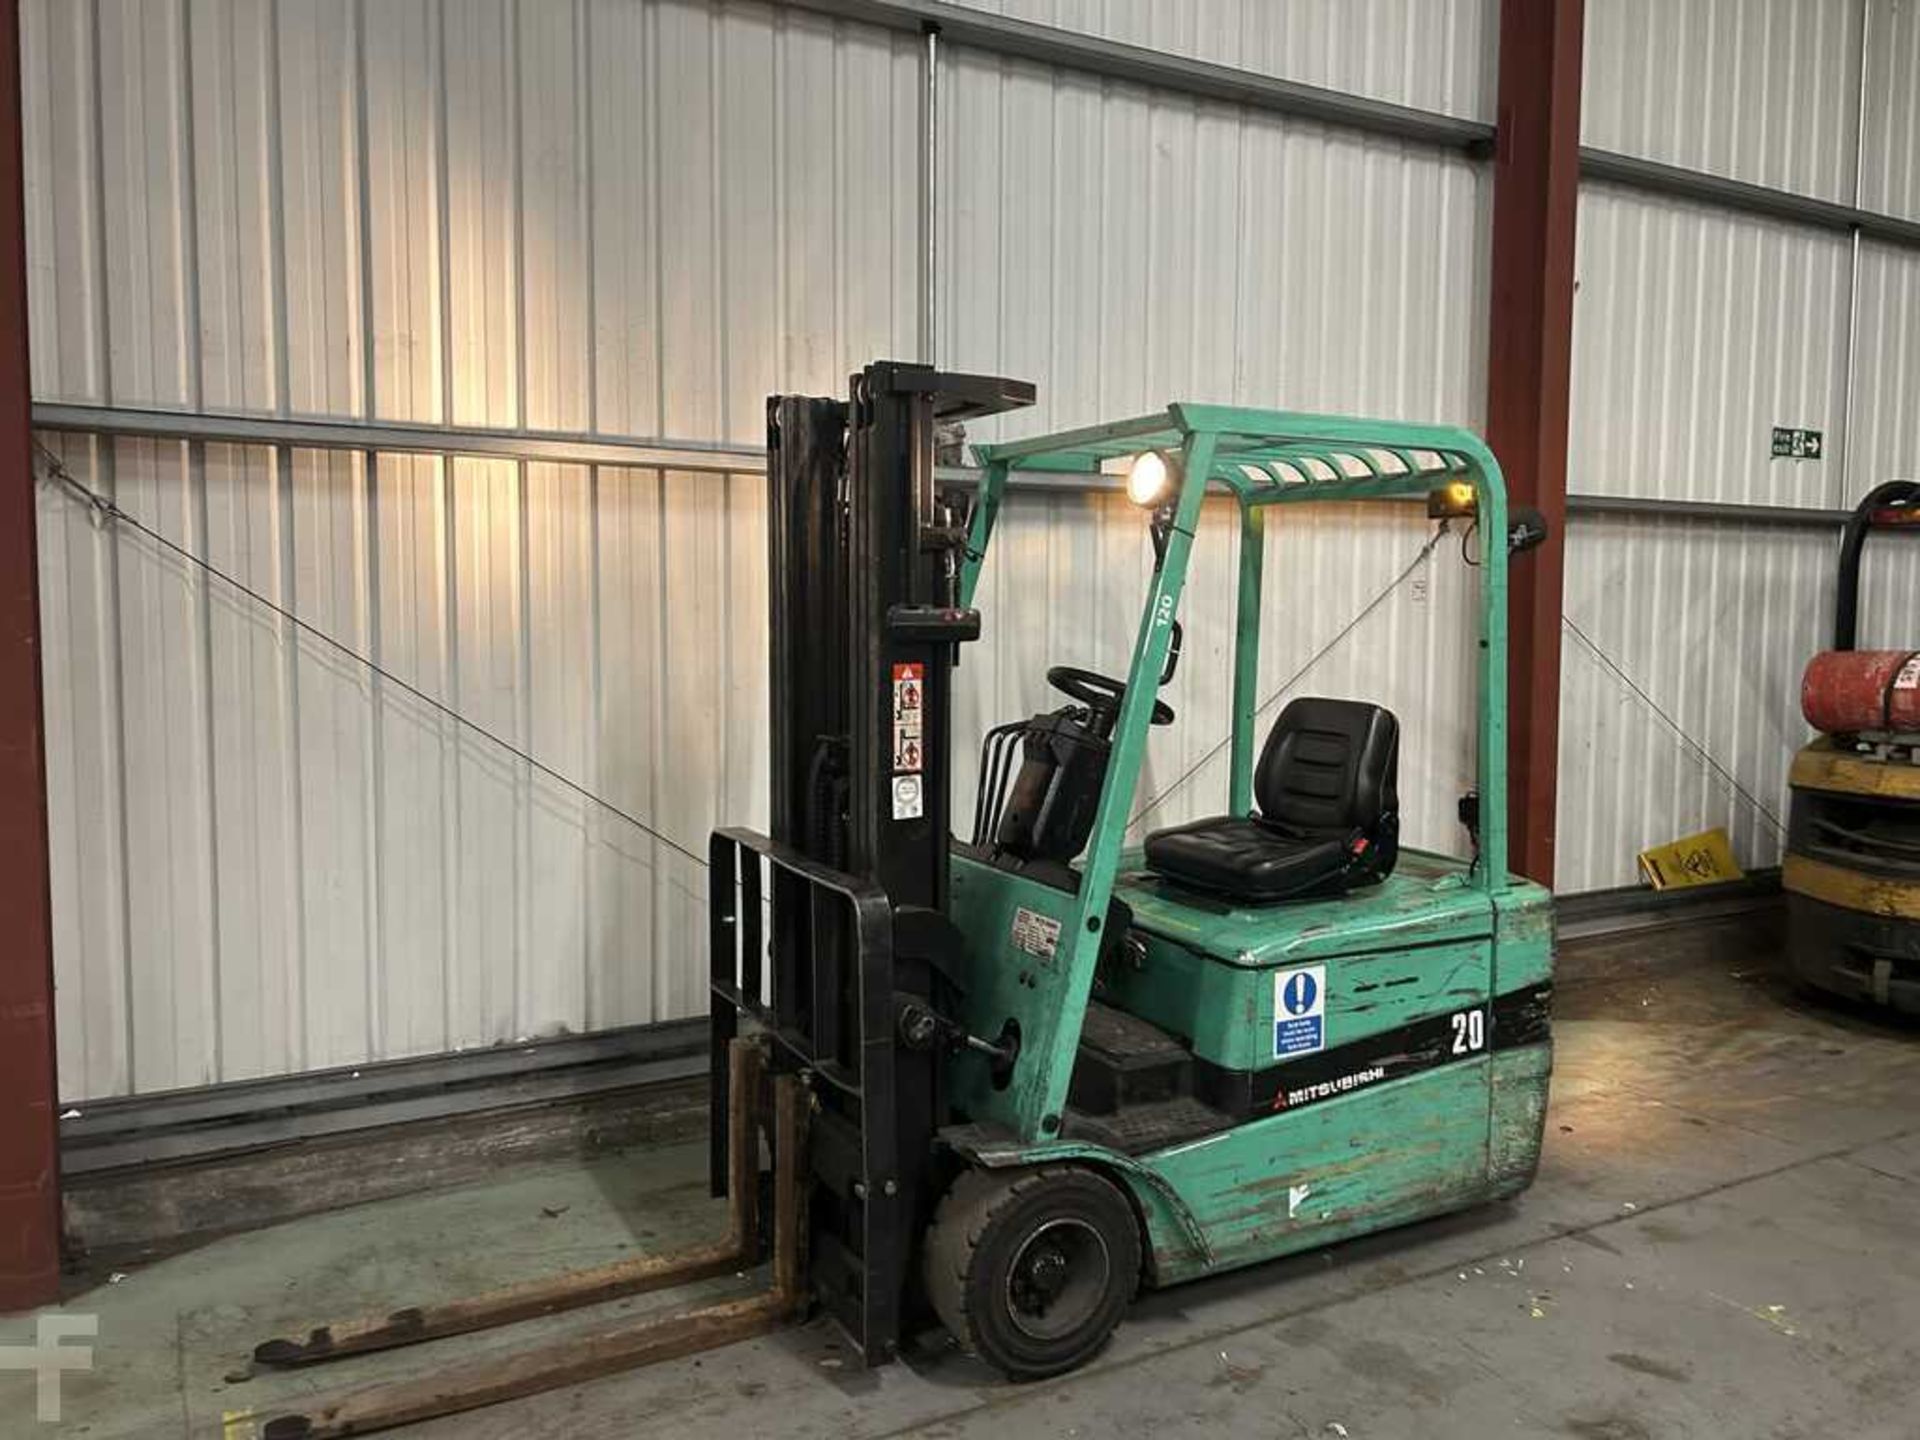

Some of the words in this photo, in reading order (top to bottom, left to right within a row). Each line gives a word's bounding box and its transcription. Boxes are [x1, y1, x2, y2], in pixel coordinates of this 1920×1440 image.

[1156, 594, 1173, 627] 120
[1452, 1010, 1484, 1054] 20
[1288, 1067, 1385, 1106] MITSUBISHI
